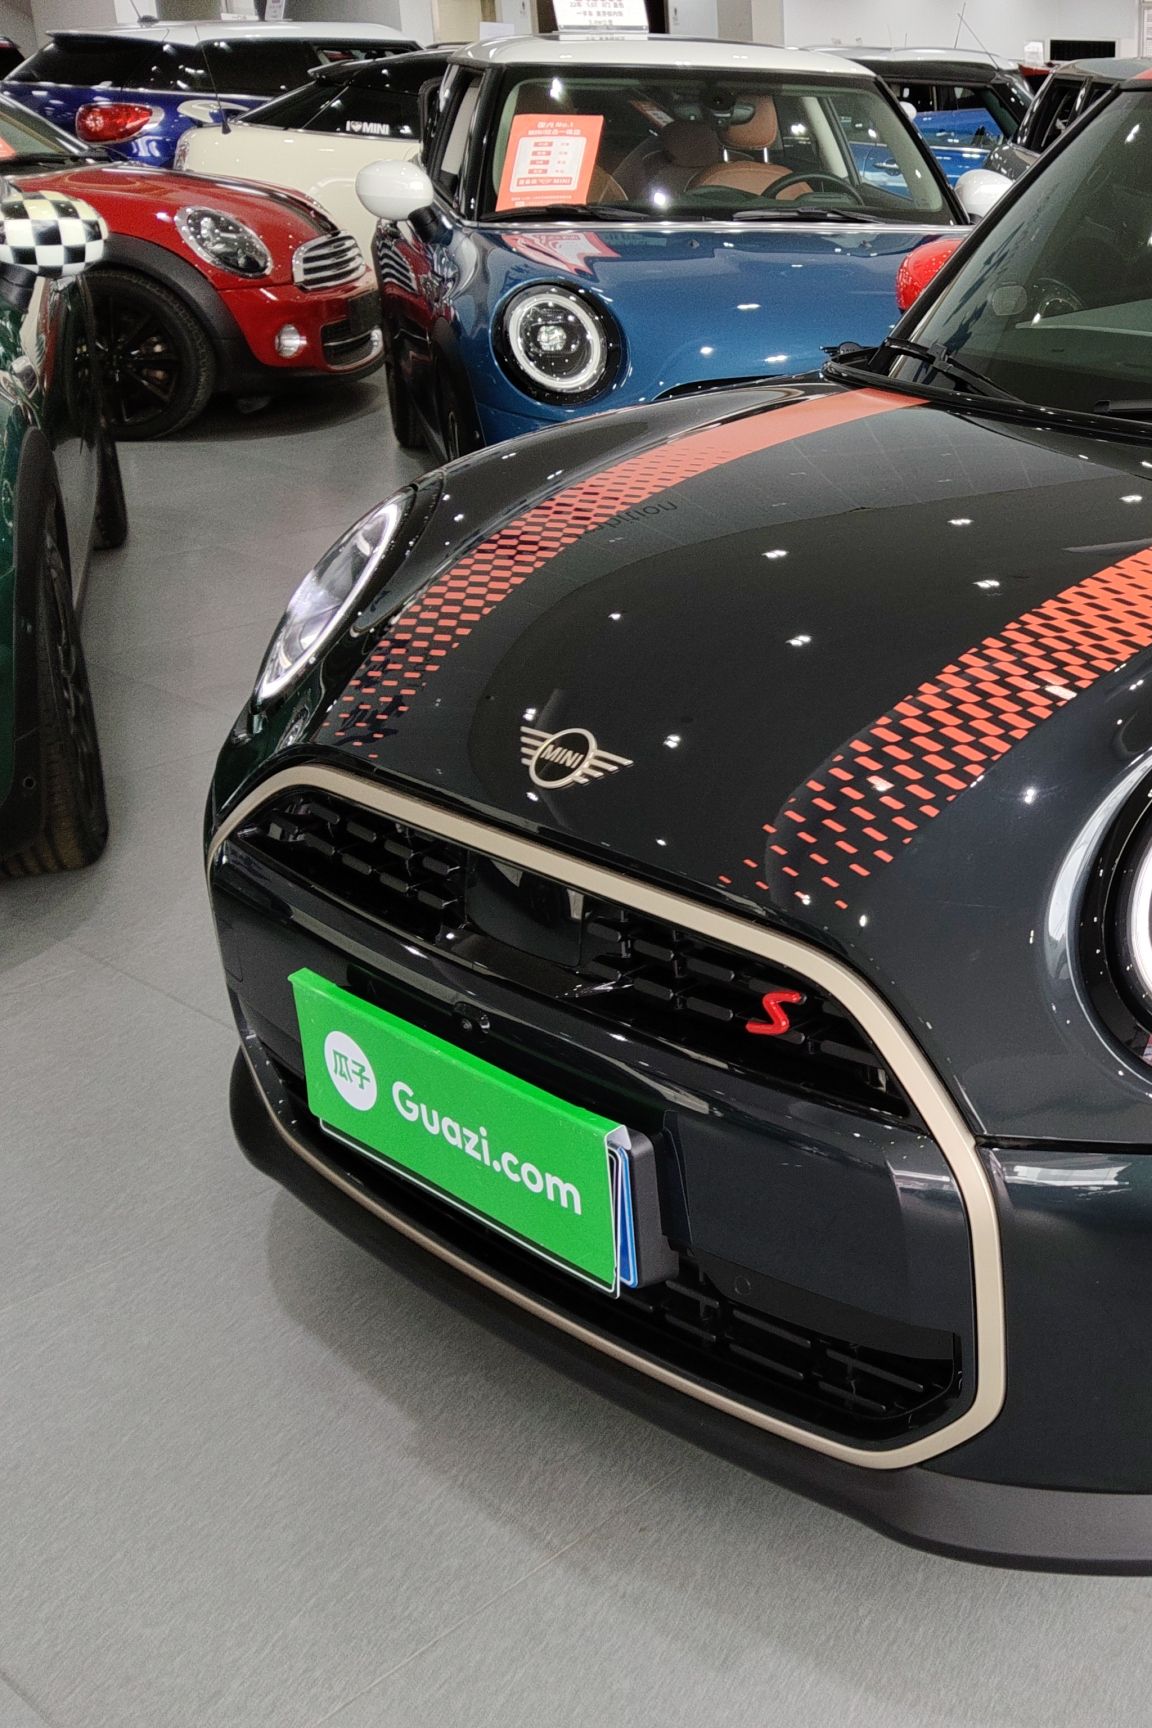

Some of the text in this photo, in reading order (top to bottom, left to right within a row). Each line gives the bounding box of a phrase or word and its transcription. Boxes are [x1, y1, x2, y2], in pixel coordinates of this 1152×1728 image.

[540, 744, 584, 769] MINI
[746, 990, 801, 1036] S
[331, 1048, 371, 1090] 瓜子
[391, 1080, 582, 1216] Guazi.com
